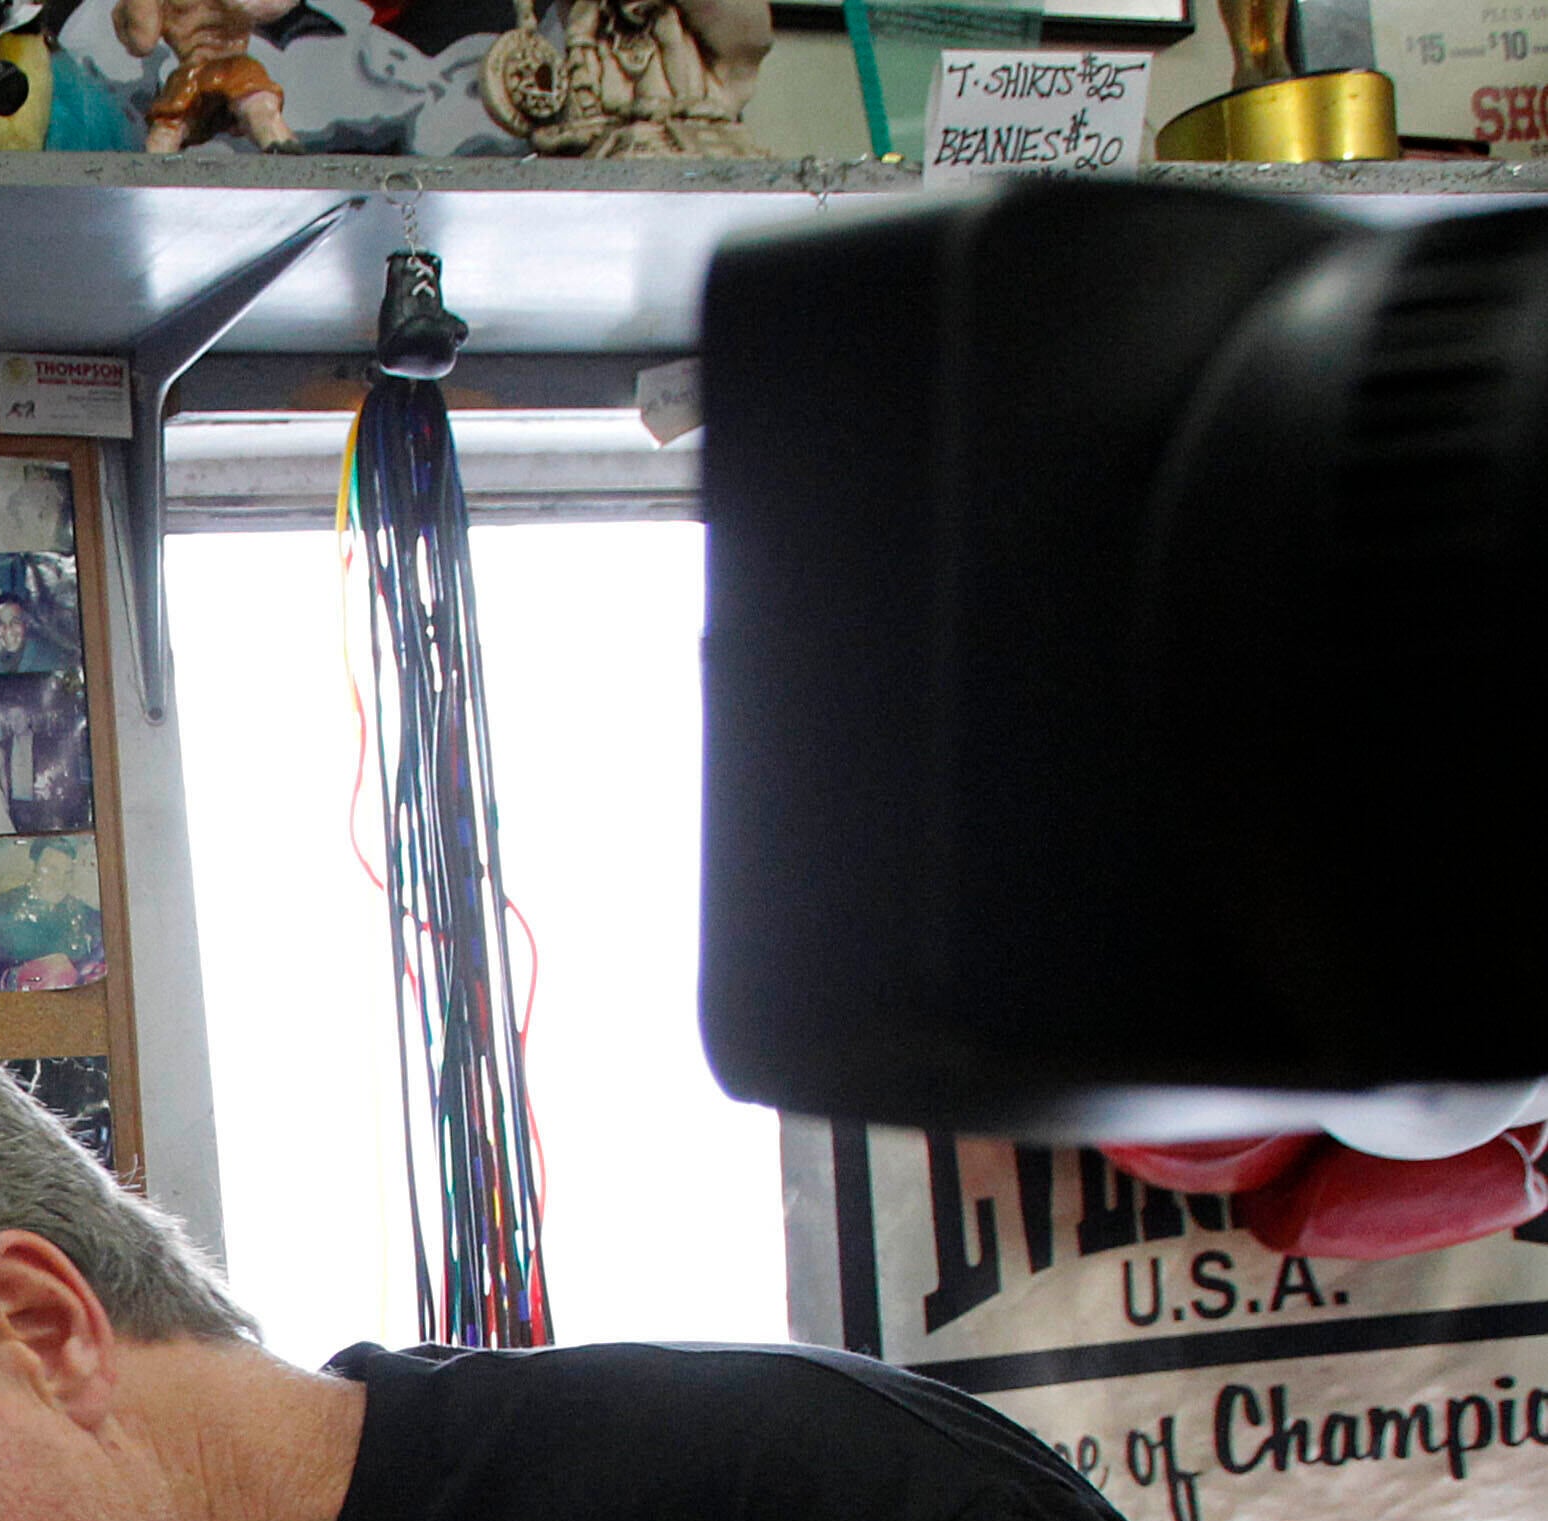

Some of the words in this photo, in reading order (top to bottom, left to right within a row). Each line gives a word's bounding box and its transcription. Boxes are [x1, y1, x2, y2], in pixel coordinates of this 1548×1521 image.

[933, 125, 1061, 166] BEANIES
[35, 361, 123, 378] THOMPSON
[1122, 1250, 1352, 1328] U.S.A.
